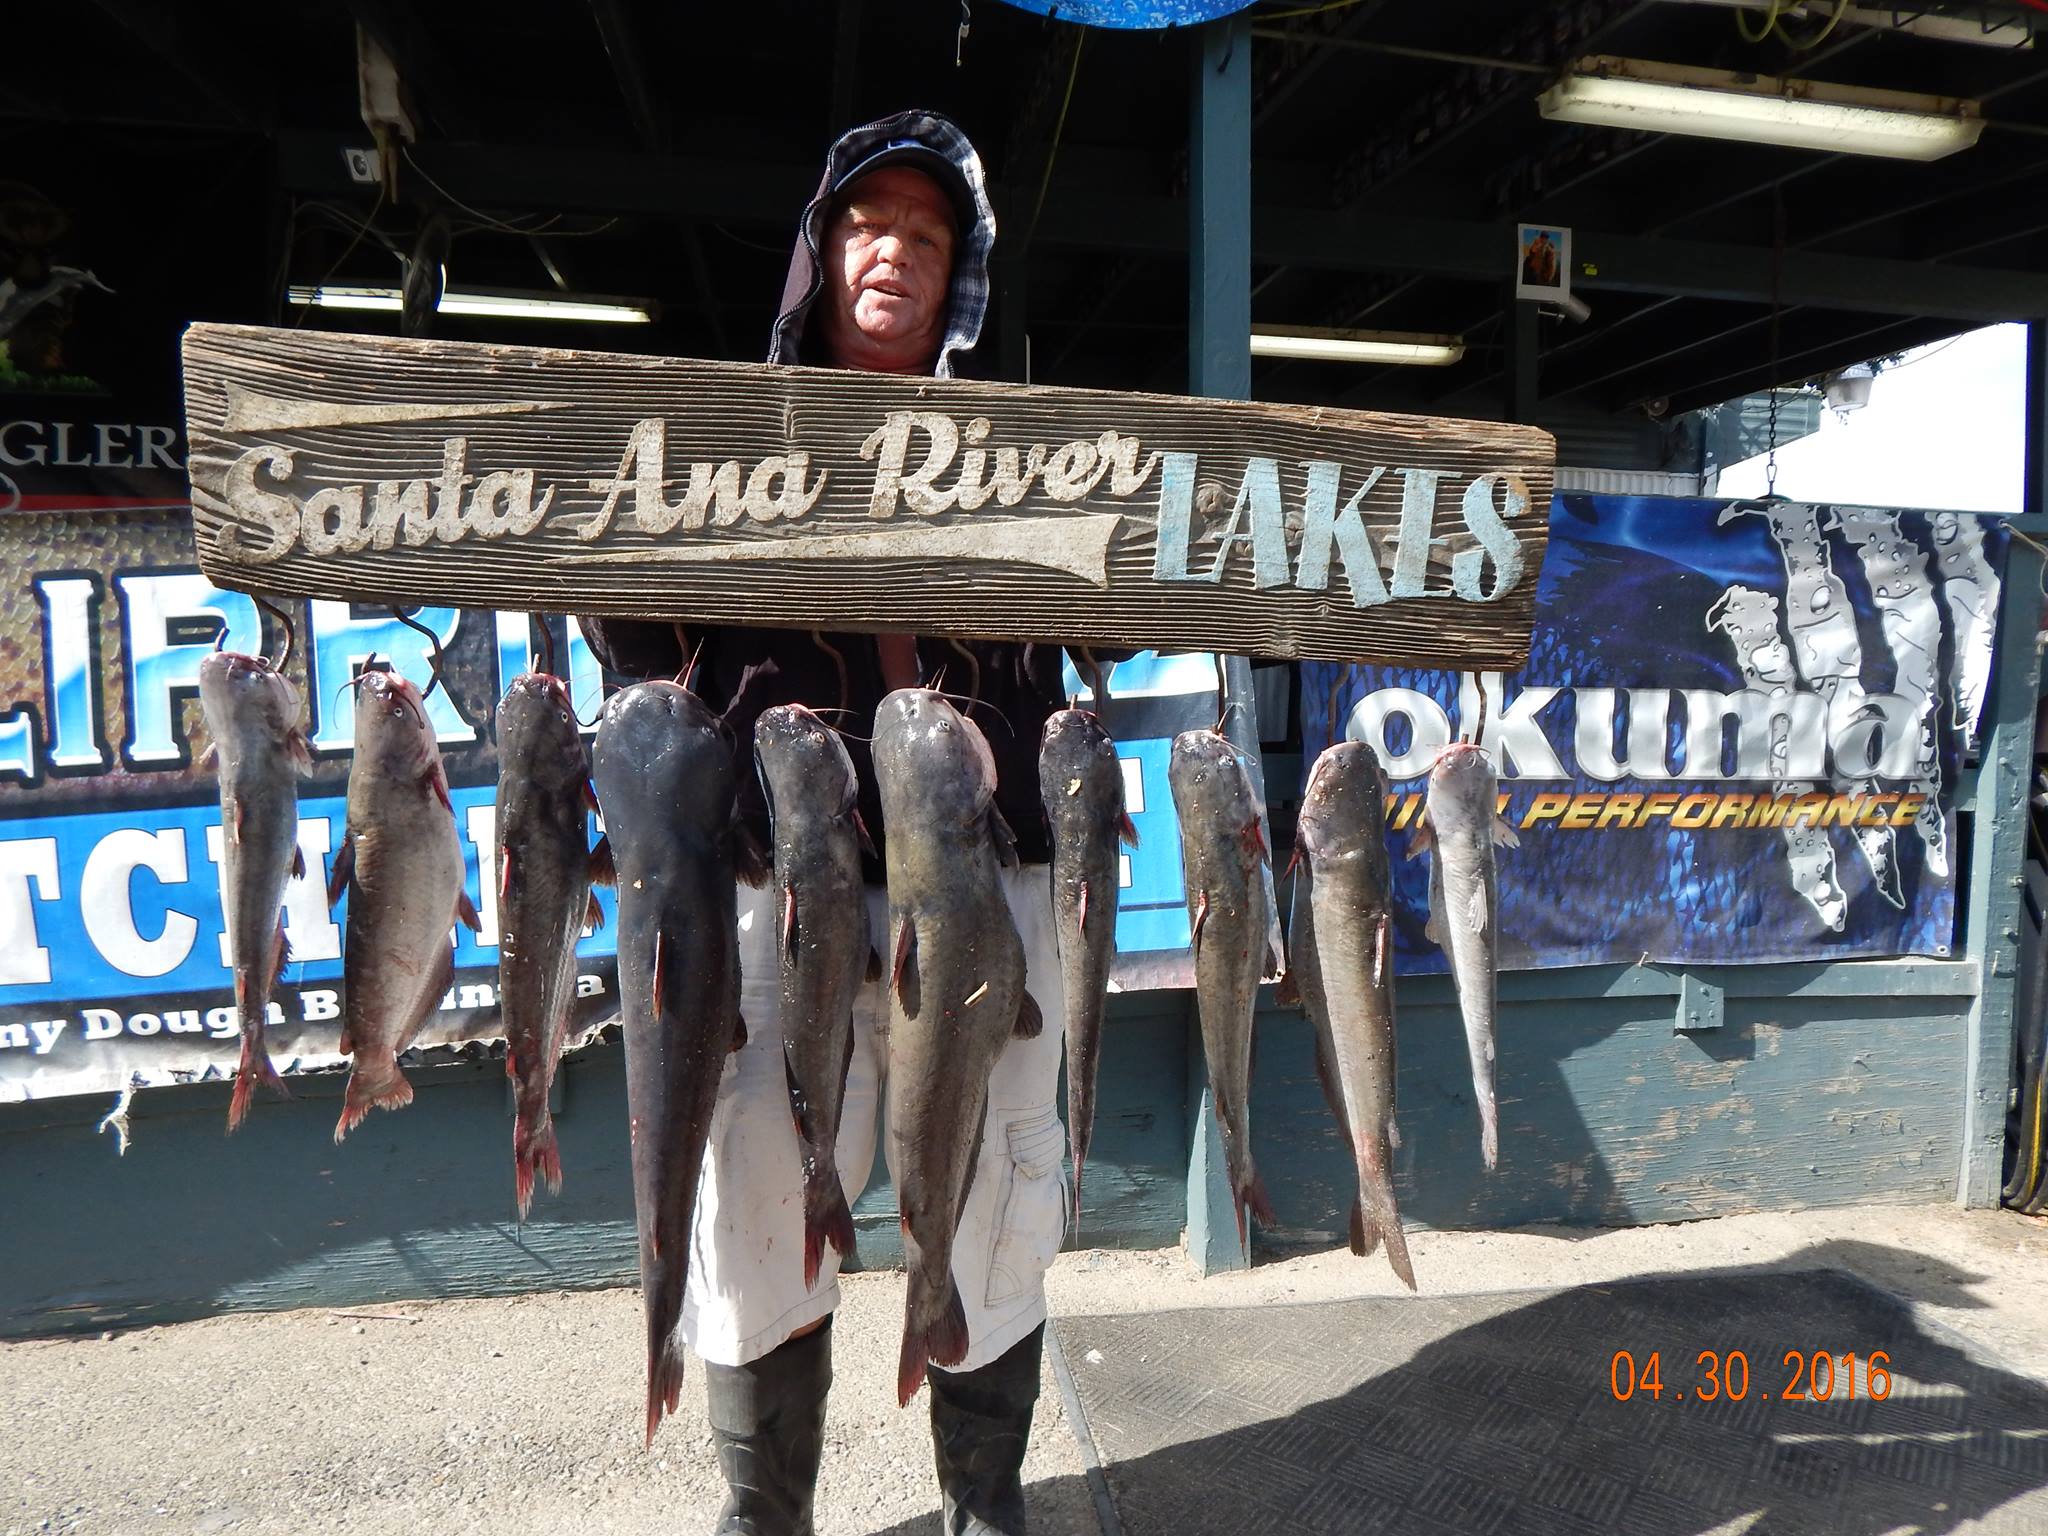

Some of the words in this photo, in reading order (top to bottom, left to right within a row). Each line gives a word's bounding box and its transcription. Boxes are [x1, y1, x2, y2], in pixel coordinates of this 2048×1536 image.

[215, 437, 556, 566] Santa
[577, 416, 829, 542] Ana
[859, 410, 1164, 519] River
[1152, 450, 1532, 609] LAKES
[1345, 671, 1923, 783] okuma
[1519, 792, 1928, 830] PERFORMANCE
